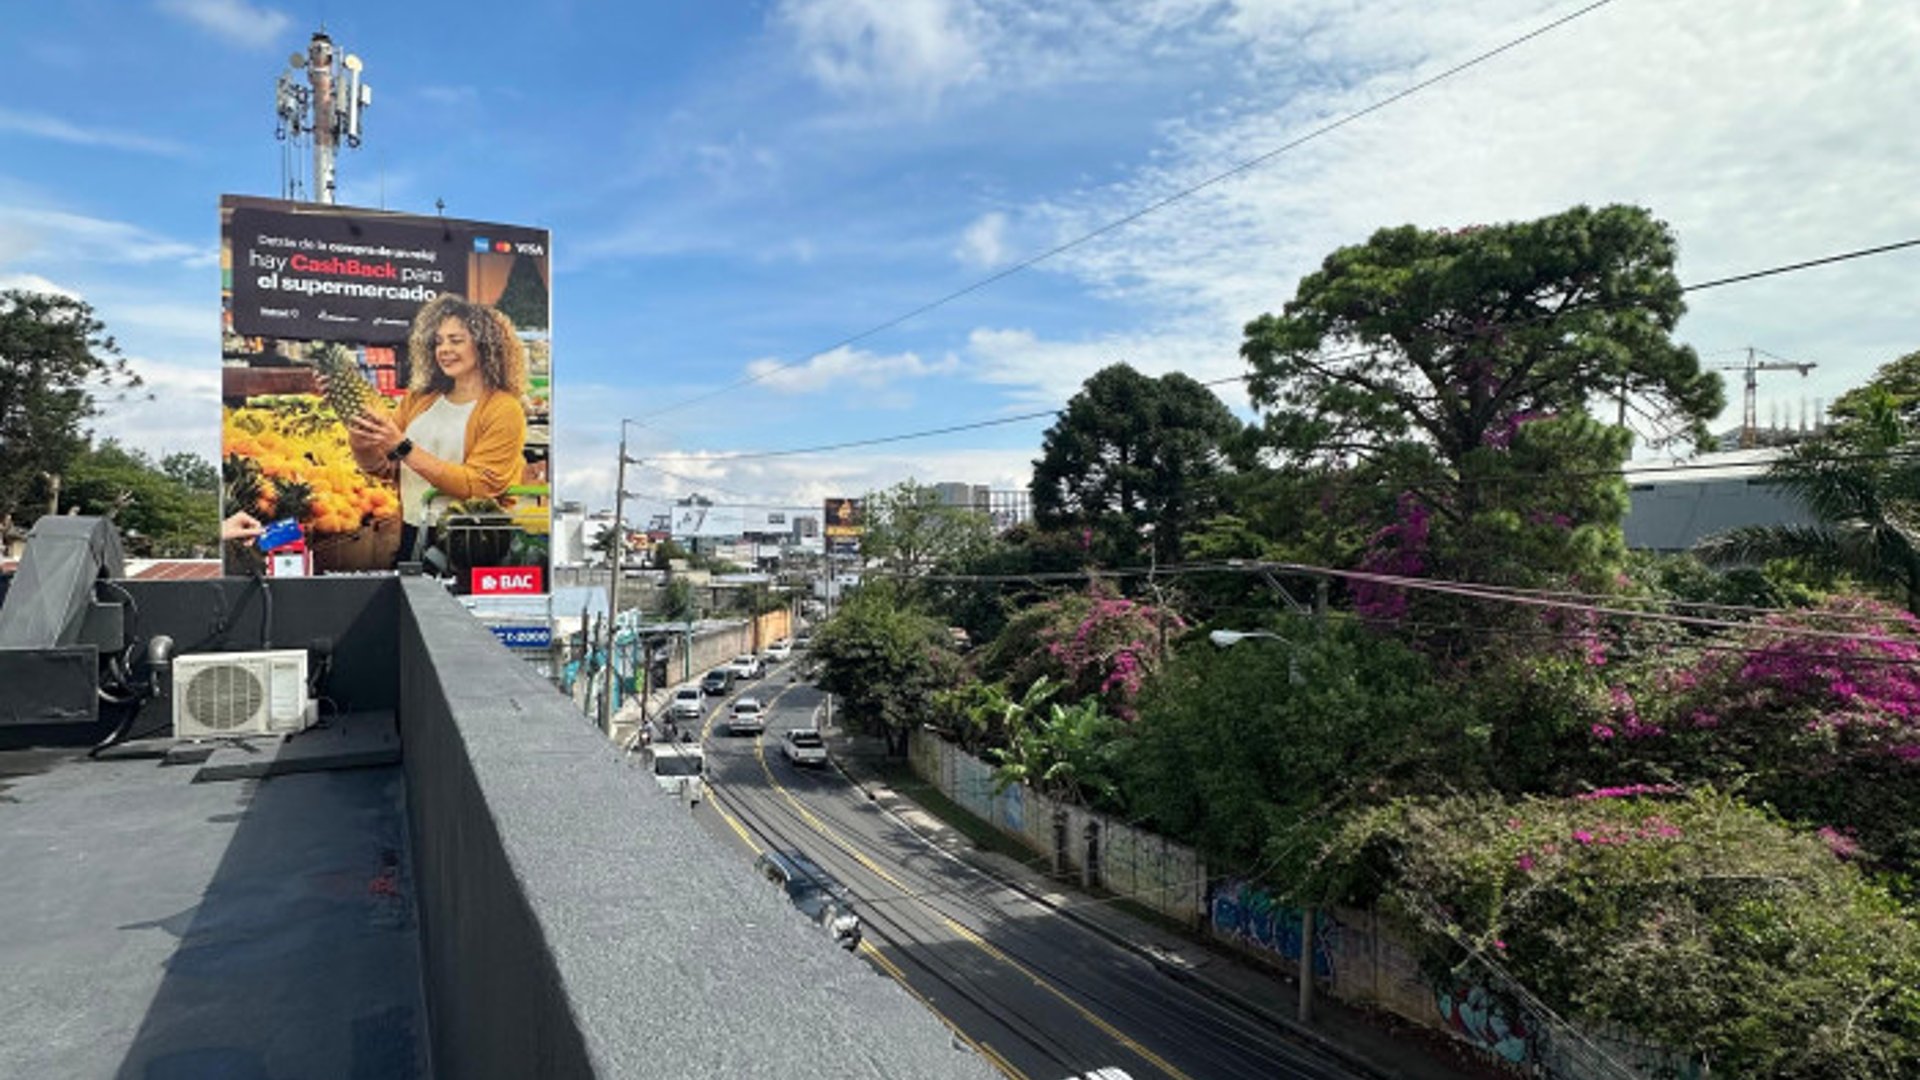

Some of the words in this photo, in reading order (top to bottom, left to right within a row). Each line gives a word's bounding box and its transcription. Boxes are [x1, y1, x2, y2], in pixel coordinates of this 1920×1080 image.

[515, 243, 543, 255] VISA
[249, 248, 288, 272] hay
[290, 253, 397, 279] CashBack
[402, 268, 443, 283] para
[257, 273, 278, 289] el
[282, 278, 437, 302] supermercado
[500, 574, 533, 589] BAC
